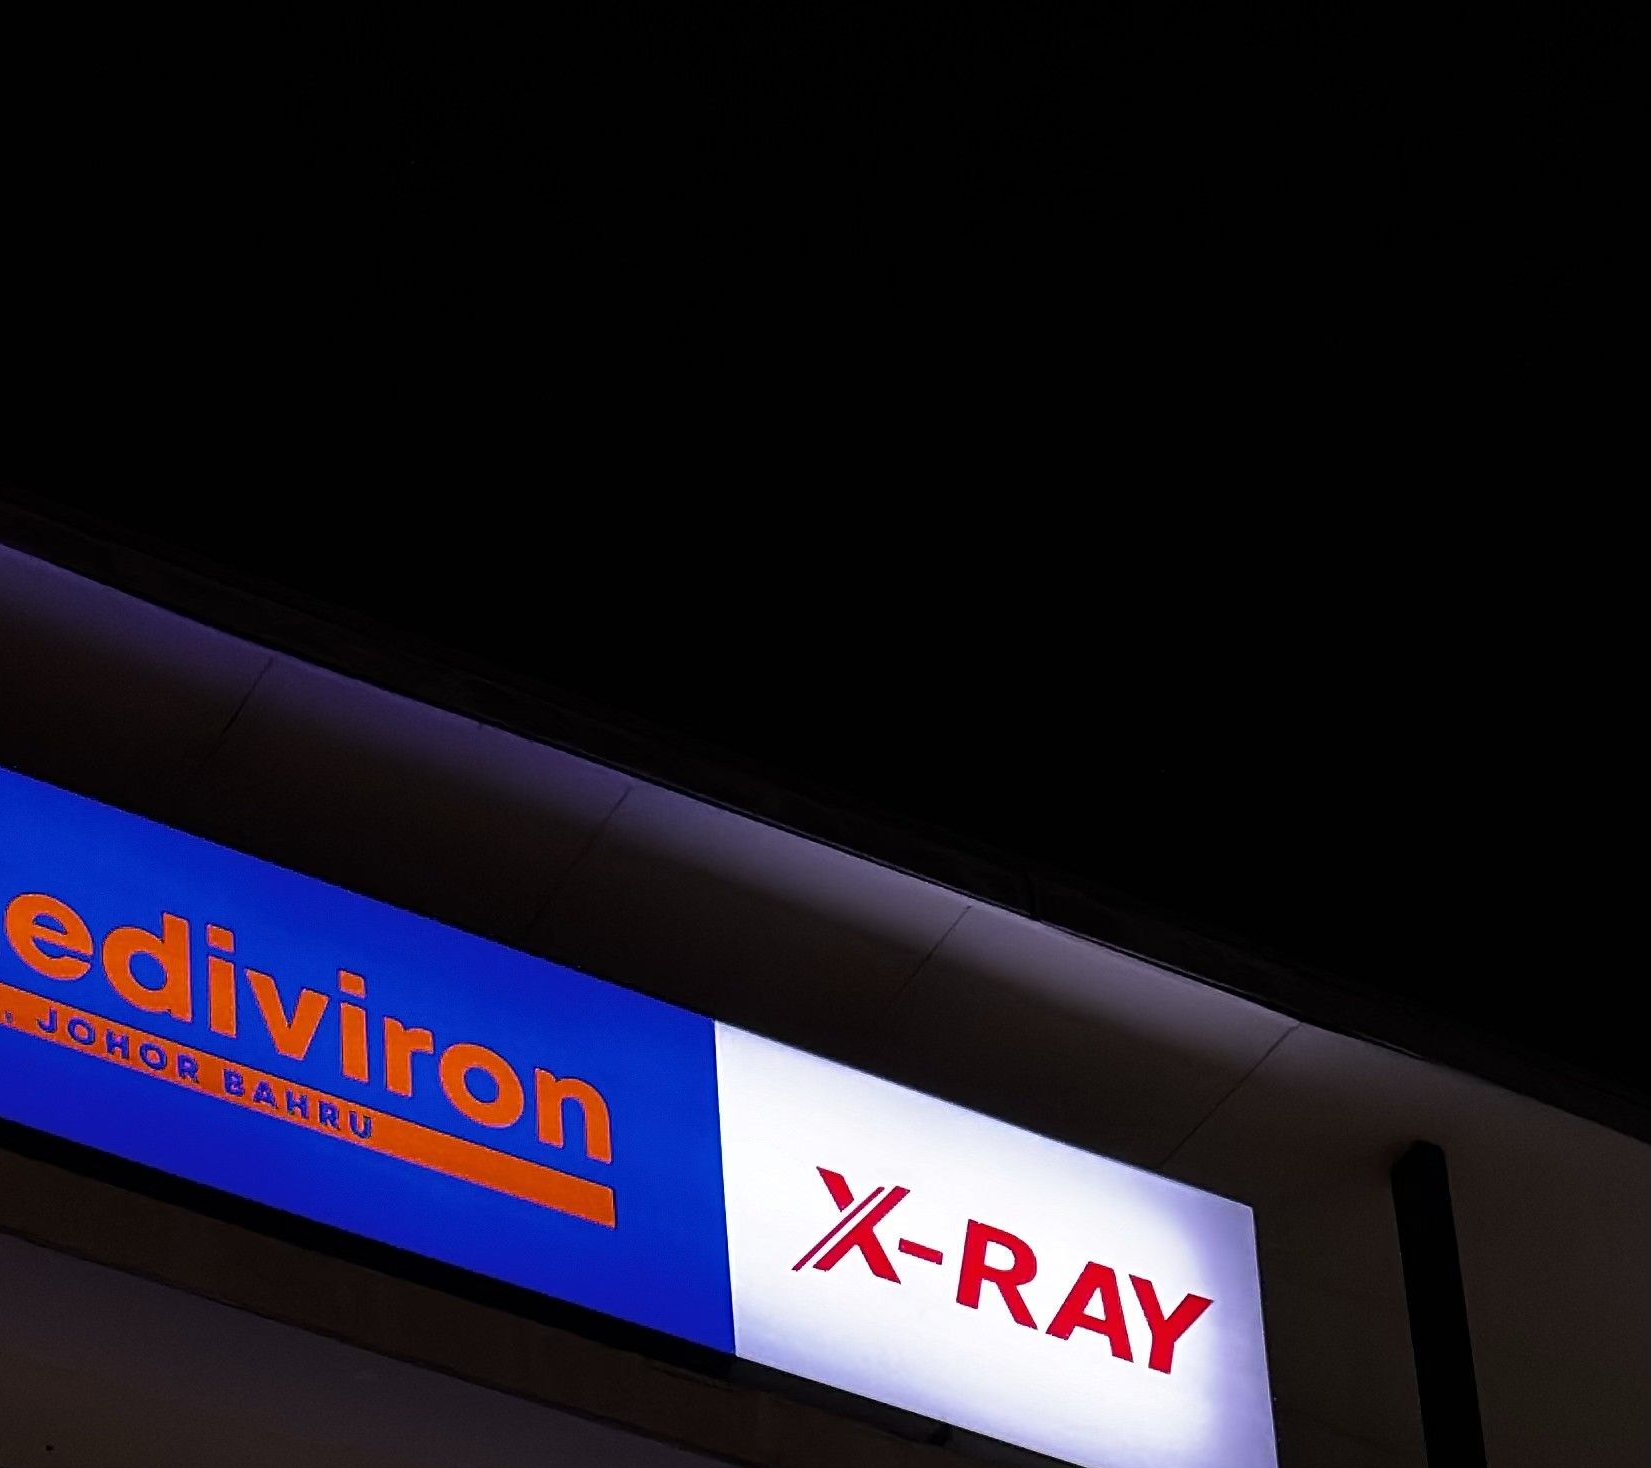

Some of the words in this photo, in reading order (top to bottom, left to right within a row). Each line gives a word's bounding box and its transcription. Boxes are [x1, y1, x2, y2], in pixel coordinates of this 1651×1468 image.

[36, 1005, 202, 1086] JOHOR
[223, 1067, 375, 1142] BAHRU
[792, 1166, 1214, 1376] X-RAY
